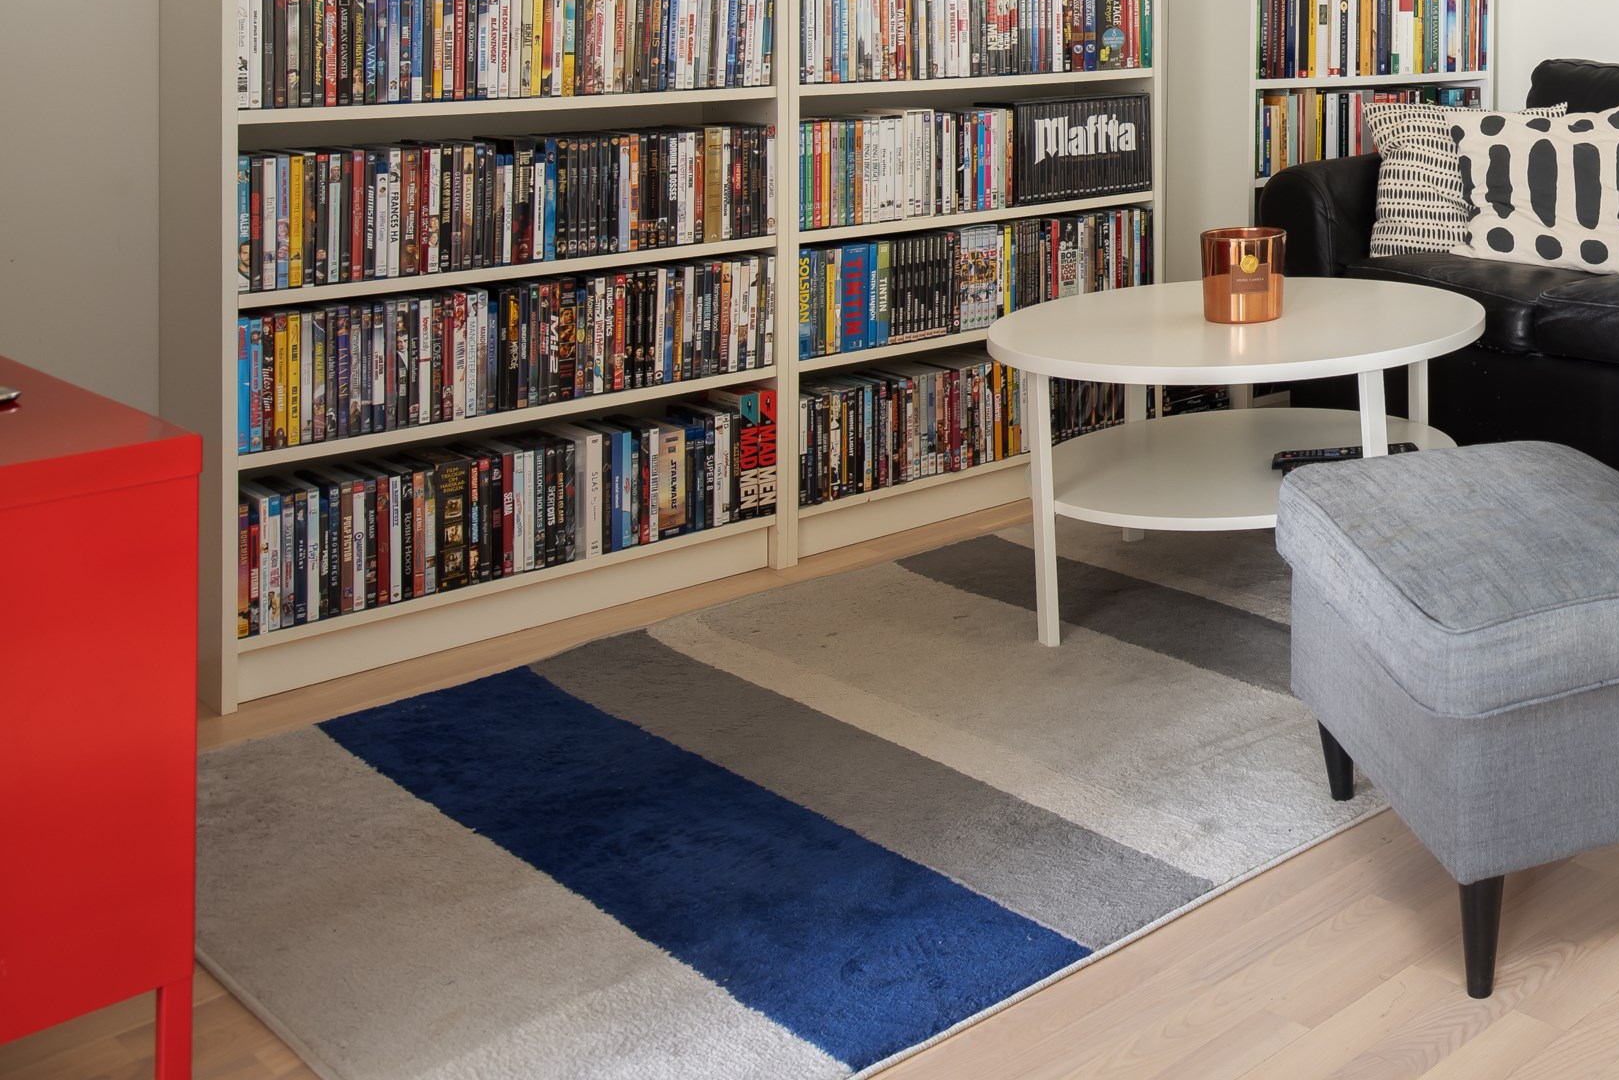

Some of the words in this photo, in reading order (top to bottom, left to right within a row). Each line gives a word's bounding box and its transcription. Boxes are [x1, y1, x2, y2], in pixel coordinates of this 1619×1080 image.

[445, 31, 453, 41] BIG
[490, 17, 498, 65] BLÅSNINGEN
[524, 23, 532, 48] BORAT
[616, 4, 624, 55] CHURCHILL
[987, 23, 998, 51] MEN
[367, 43, 375, 86] AVATAR
[444, 41, 453, 71] LEBOWSKI
[1034, 113, 1136, 165] Maffia
[520, 149, 533, 165] The
[669, 137, 677, 172] HORRIBLE
[442, 171, 450, 188] GANGS
[442, 188, 450, 196] OF
[669, 174, 677, 201] BOSSES
[390, 192, 399, 229] FRANCES
[442, 196, 450, 209] NEW
[442, 209, 450, 224] YORK
[390, 230, 398, 243] HA
[1060, 251, 1077, 260] BOB
[606, 287, 614, 311] music
[712, 283, 720, 314] Norwegian
[799, 257, 810, 323] SOLSIDAN
[845, 256, 863, 336] TINTIN
[879, 277, 888, 312] TINTIN
[605, 315, 613, 337] lyrics
[703, 319, 711, 331] BOY
[339, 348, 348, 360] LA
[433, 342, 441, 360] LOVE
[468, 321, 476, 374] MANCHESTER
[262, 366, 273, 390] Jules
[339, 362, 348, 374] LA
[433, 369, 441, 393] MERCY
[262, 395, 273, 412] Jim
[275, 383, 286, 412] julieta
[739, 427, 758, 470] MAD
[759, 424, 777, 467] MAD
[471, 467, 479, 491] SATURDAY
[740, 469, 758, 510] MEN
[759, 465, 776, 506] MEN
[504, 492, 513, 516] SELMA
[343, 515, 352, 535] PULP
[240, 529, 248, 565] BOHEMIAN
[285, 524, 293, 563] PATTON
[343, 535, 352, 563] FICTION
[354, 531, 364, 572] QUADROPHENIA
[404, 545, 412, 575] HOOD
